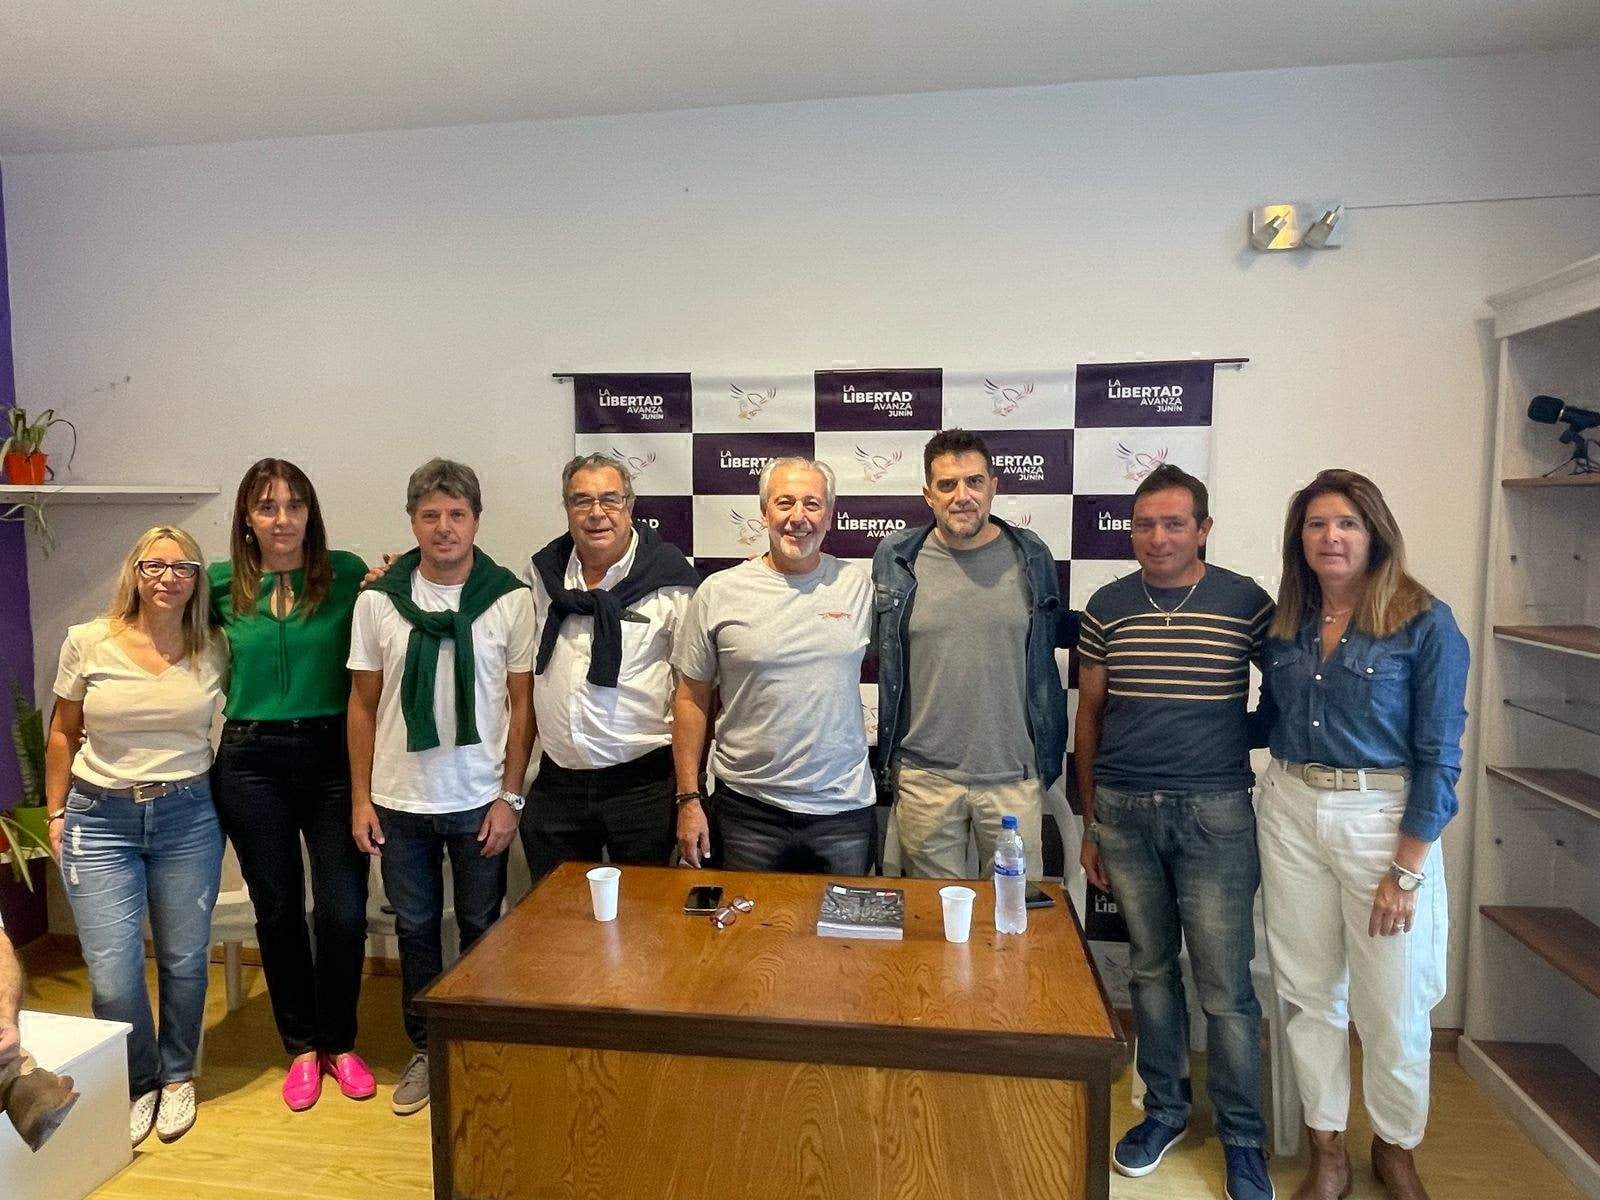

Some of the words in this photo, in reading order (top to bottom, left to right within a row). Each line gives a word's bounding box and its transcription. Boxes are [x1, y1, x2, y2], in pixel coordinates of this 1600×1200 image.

[1108, 379, 1121, 387] LA
[599, 388, 610, 396] LA
[1108, 385, 1183, 398] LIBERTAD
[600, 396, 663, 406] LIBERTAD
[843, 391, 912, 403] LIBERTAD
[1140, 397, 1182, 406] AVANZA
[627, 406, 663, 414] AVANZA
[873, 402, 912, 411] AVANZA
[720, 457, 774, 468] LIBERT
[991, 455, 1044, 467] ERTAD
[1003, 466, 1043, 474] AVANZA
[837, 511, 849, 519] LA
[1099, 511, 1112, 519] LA
[837, 519, 907, 530] LIBERTAD
[1098, 519, 1132, 531] LIBE
[1094, 894, 1107, 902] LA
